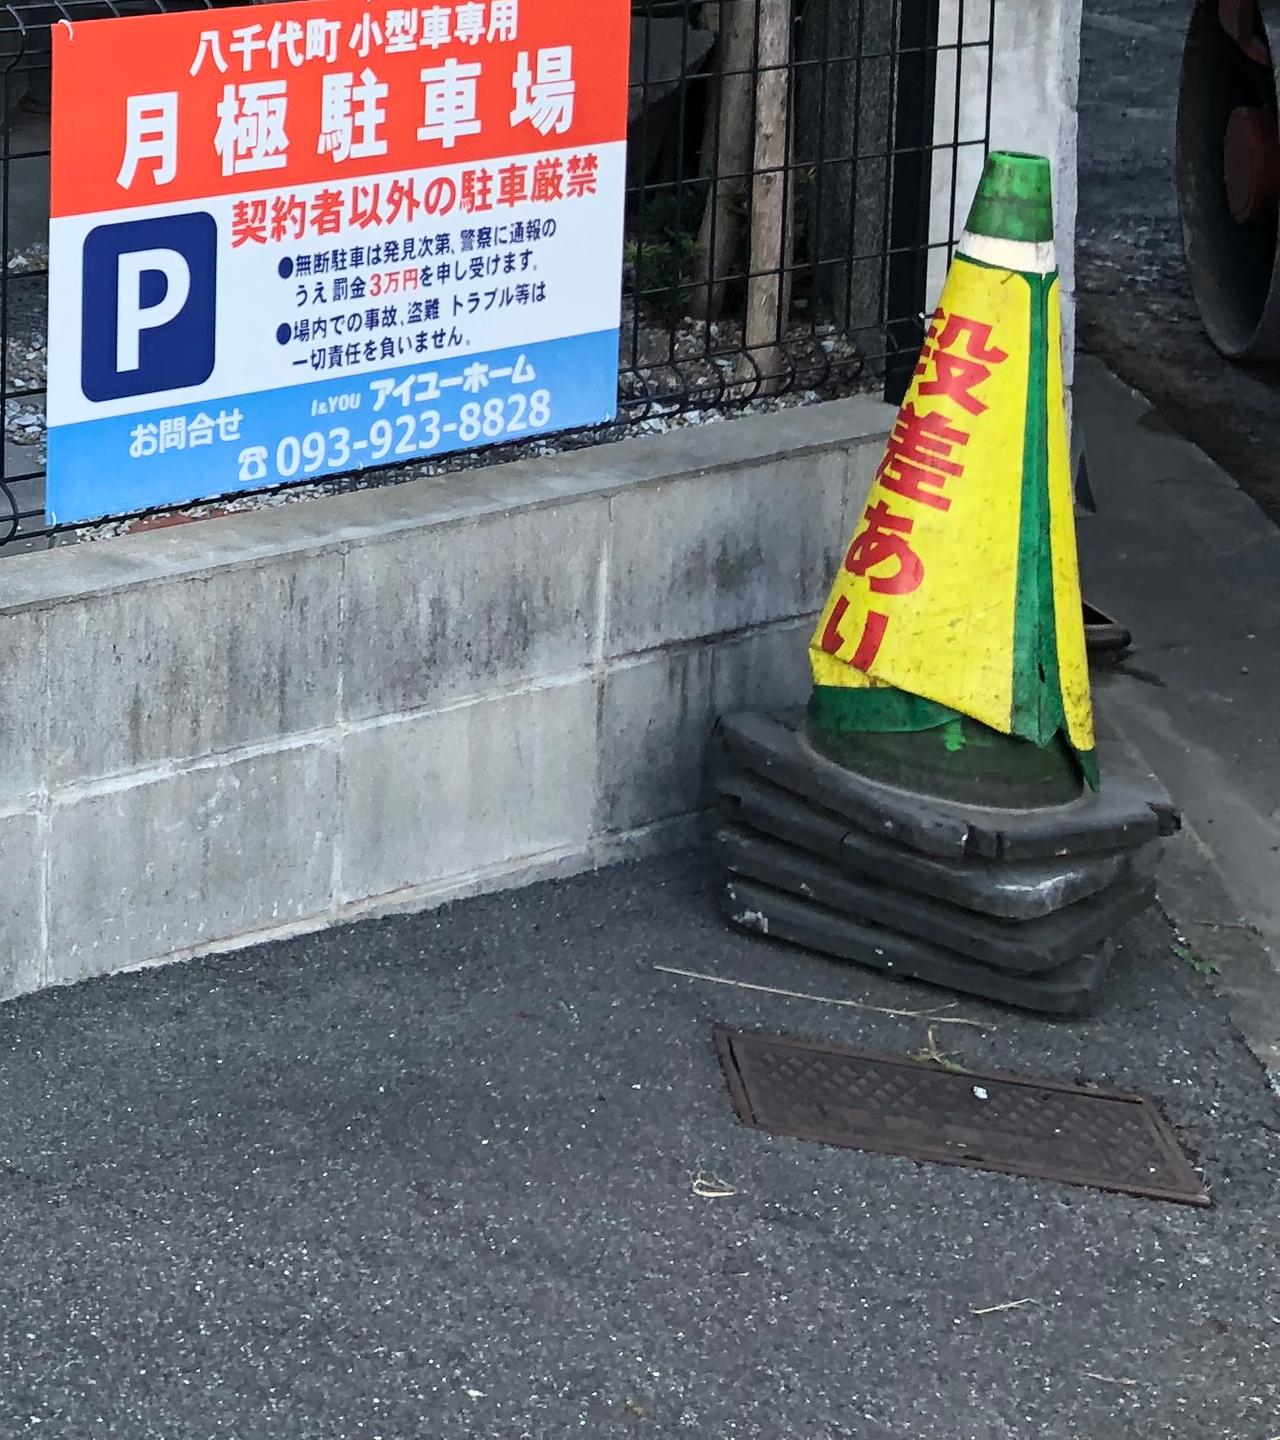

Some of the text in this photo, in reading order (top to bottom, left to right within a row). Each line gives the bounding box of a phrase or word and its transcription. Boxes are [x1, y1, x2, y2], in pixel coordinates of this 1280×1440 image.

[189, 18, 340, 77] 八千代町
[116, 45, 577, 190] 月極駐車場
[230, 153, 599, 248] 契約者以外の駐車厳禁
[116, 247, 191, 373] P
[292, 326, 471, 372] 一切責任を負いません。
[369, 354, 537, 413] アイユーホーム
[128, 407, 244, 459] お問合せ
[276, 388, 552, 478] 093-923-8828
[820, 307, 1010, 673] 段差あり
